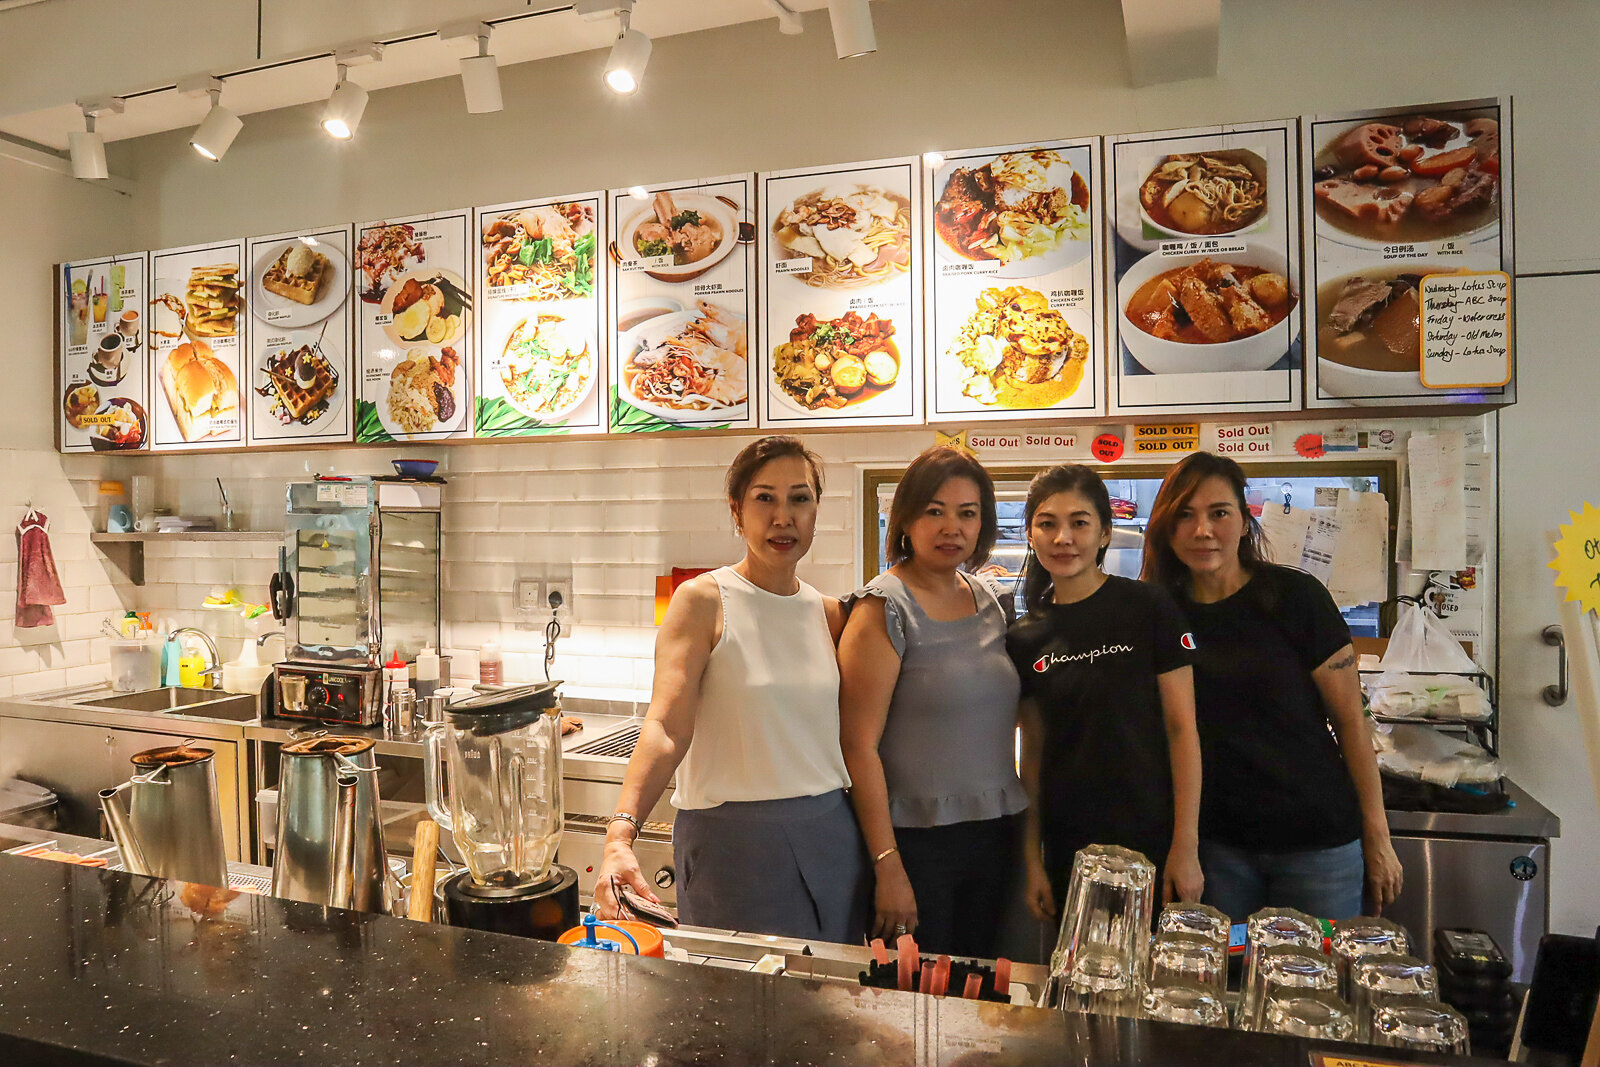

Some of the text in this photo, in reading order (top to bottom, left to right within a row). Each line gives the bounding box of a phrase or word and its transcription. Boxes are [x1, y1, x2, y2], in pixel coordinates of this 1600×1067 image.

[1204, 240, 1219, 248] 面包
[1447, 242, 1455, 250] 饭
[1383, 245, 1414, 254] 今日例汤
[1050, 289, 1084, 297] 鸡扒咖喱饭
[1465, 296, 1486, 306] ABC
[1426, 314, 1454, 330] Friday
[1465, 329, 1480, 341] Old
[1480, 328, 1503, 339] Melon
[1425, 347, 1454, 363] Sunday
[1486, 344, 1507, 357] Soup
[83, 416, 99, 424] SOLD
[1138, 426, 1194, 436] SOLD OUT
[1217, 425, 1270, 439] Sold Out
[971, 437, 996, 447] Sold
[999, 437, 1019, 447] Out
[1025, 435, 1074, 446] Sold Out
[1097, 438, 1119, 448] SOLD
[1138, 441, 1194, 451] SOLD OUT
[1217, 442, 1270, 453] Sold Out
[1099, 449, 1115, 457] OUT
[1032, 643, 1134, 673] Champion
